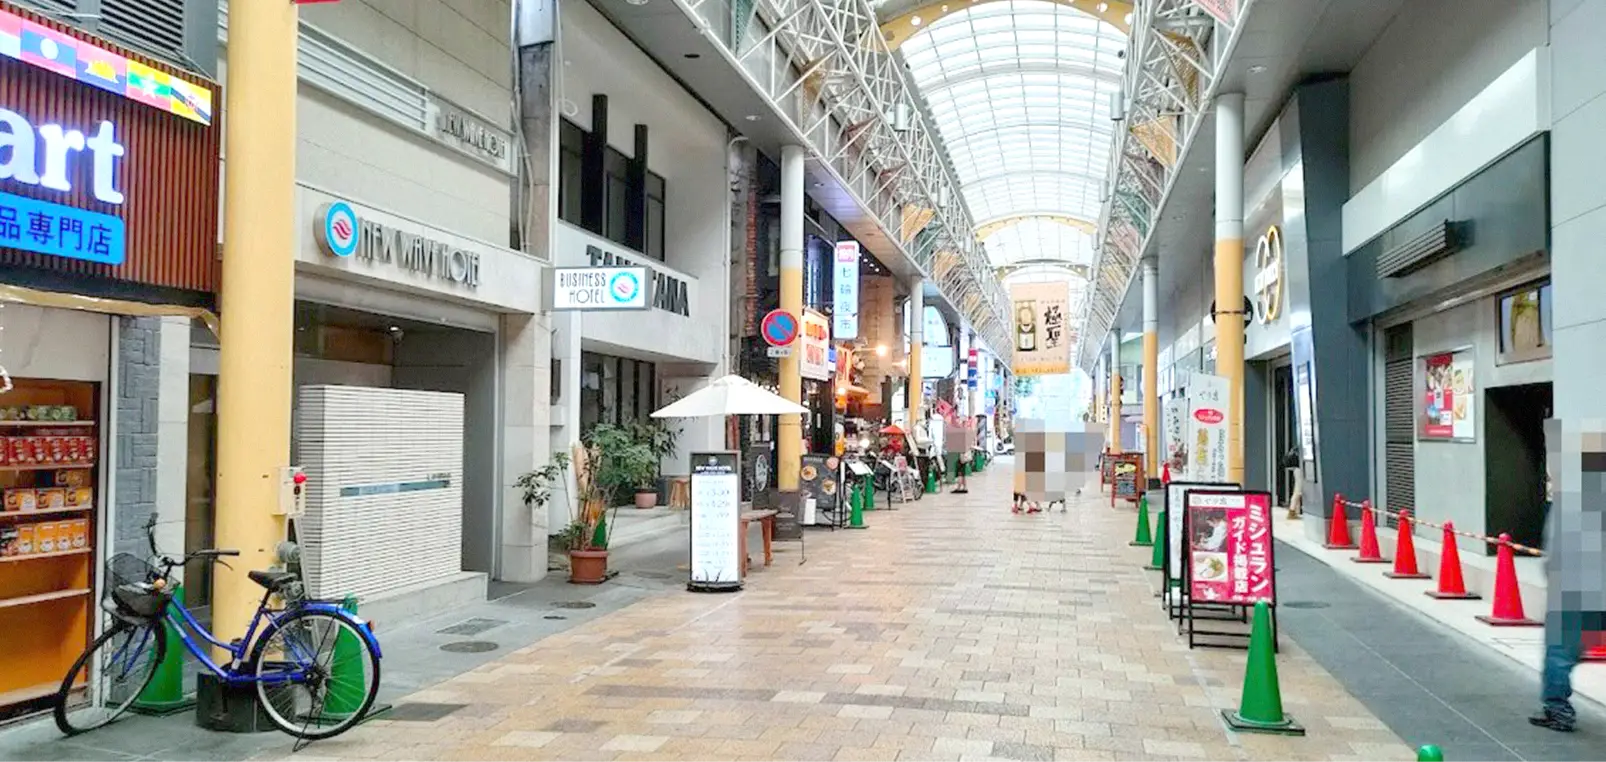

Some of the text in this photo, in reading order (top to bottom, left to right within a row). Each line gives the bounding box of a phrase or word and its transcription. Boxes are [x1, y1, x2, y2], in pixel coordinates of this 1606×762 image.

[0, 108, 124, 205] art
[0, 205, 112, 256] 品専門店
[357, 217, 481, 288] NEW WAVE HOTEL
[560, 272, 607, 288] BUSINESS
[569, 288, 605, 304] HOTEL
[1232, 516, 1248, 593] ガイド掲載店
[1249, 504, 1269, 593] ミシュラン
